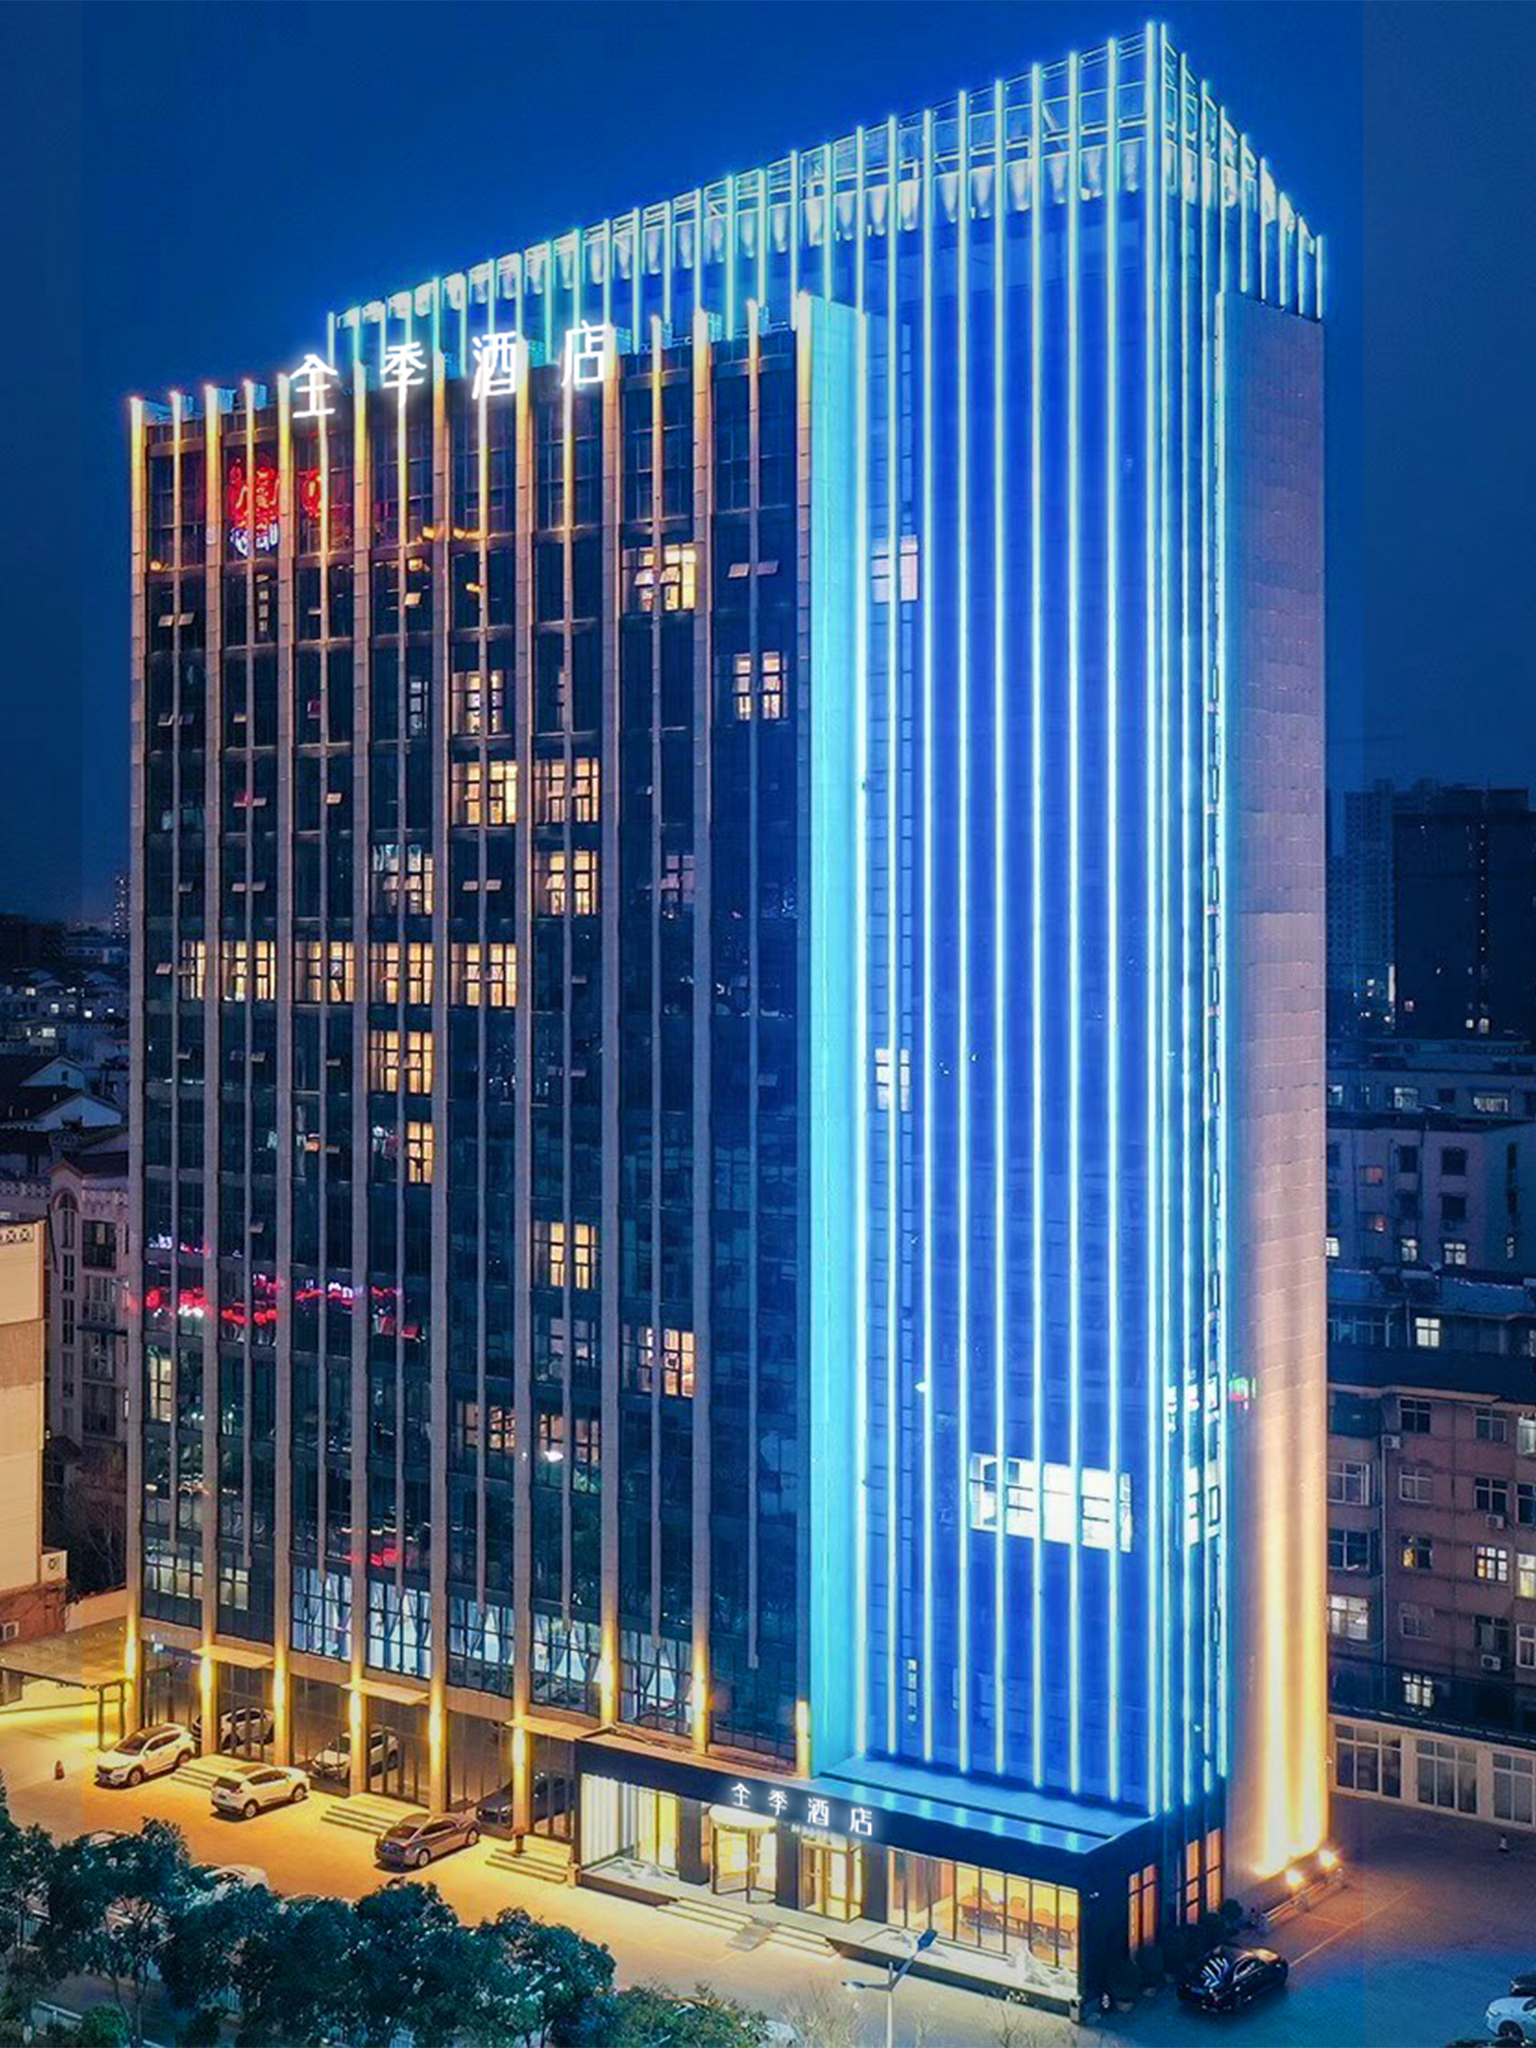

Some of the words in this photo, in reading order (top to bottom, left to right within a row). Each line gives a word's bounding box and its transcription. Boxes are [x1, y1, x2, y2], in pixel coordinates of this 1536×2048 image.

[289, 320, 609, 418] 全季酒店
[731, 1782, 873, 1836] 全季酒店
